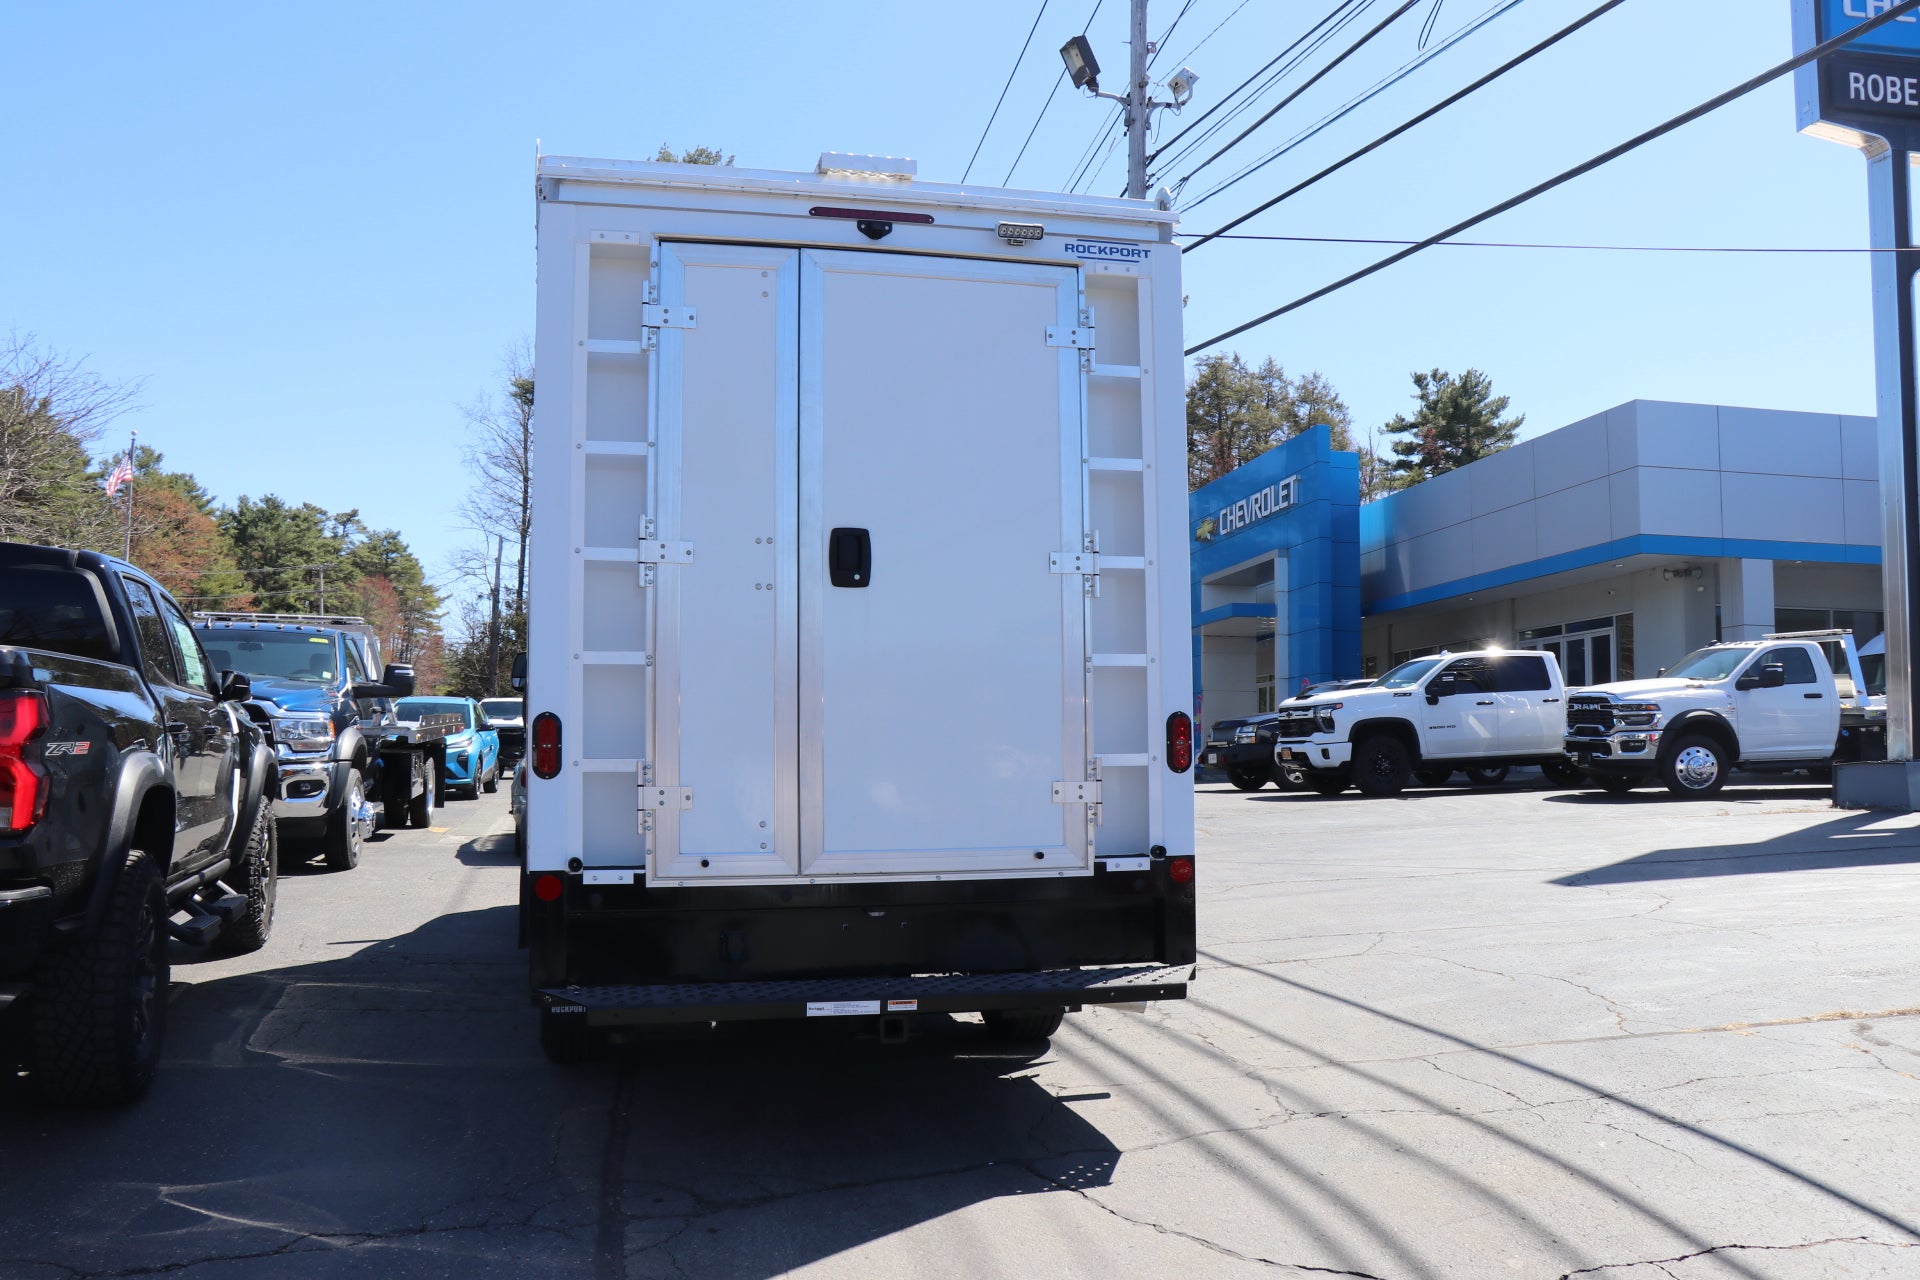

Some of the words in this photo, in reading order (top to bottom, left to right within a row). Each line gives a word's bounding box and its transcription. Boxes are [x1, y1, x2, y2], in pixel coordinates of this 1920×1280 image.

[1848, 71, 1919, 106] ROBE
[1064, 243, 1151, 259] ROCKPORT
[1219, 474, 1297, 536] CHEVROLET
[45, 741, 91, 756] ZR2
